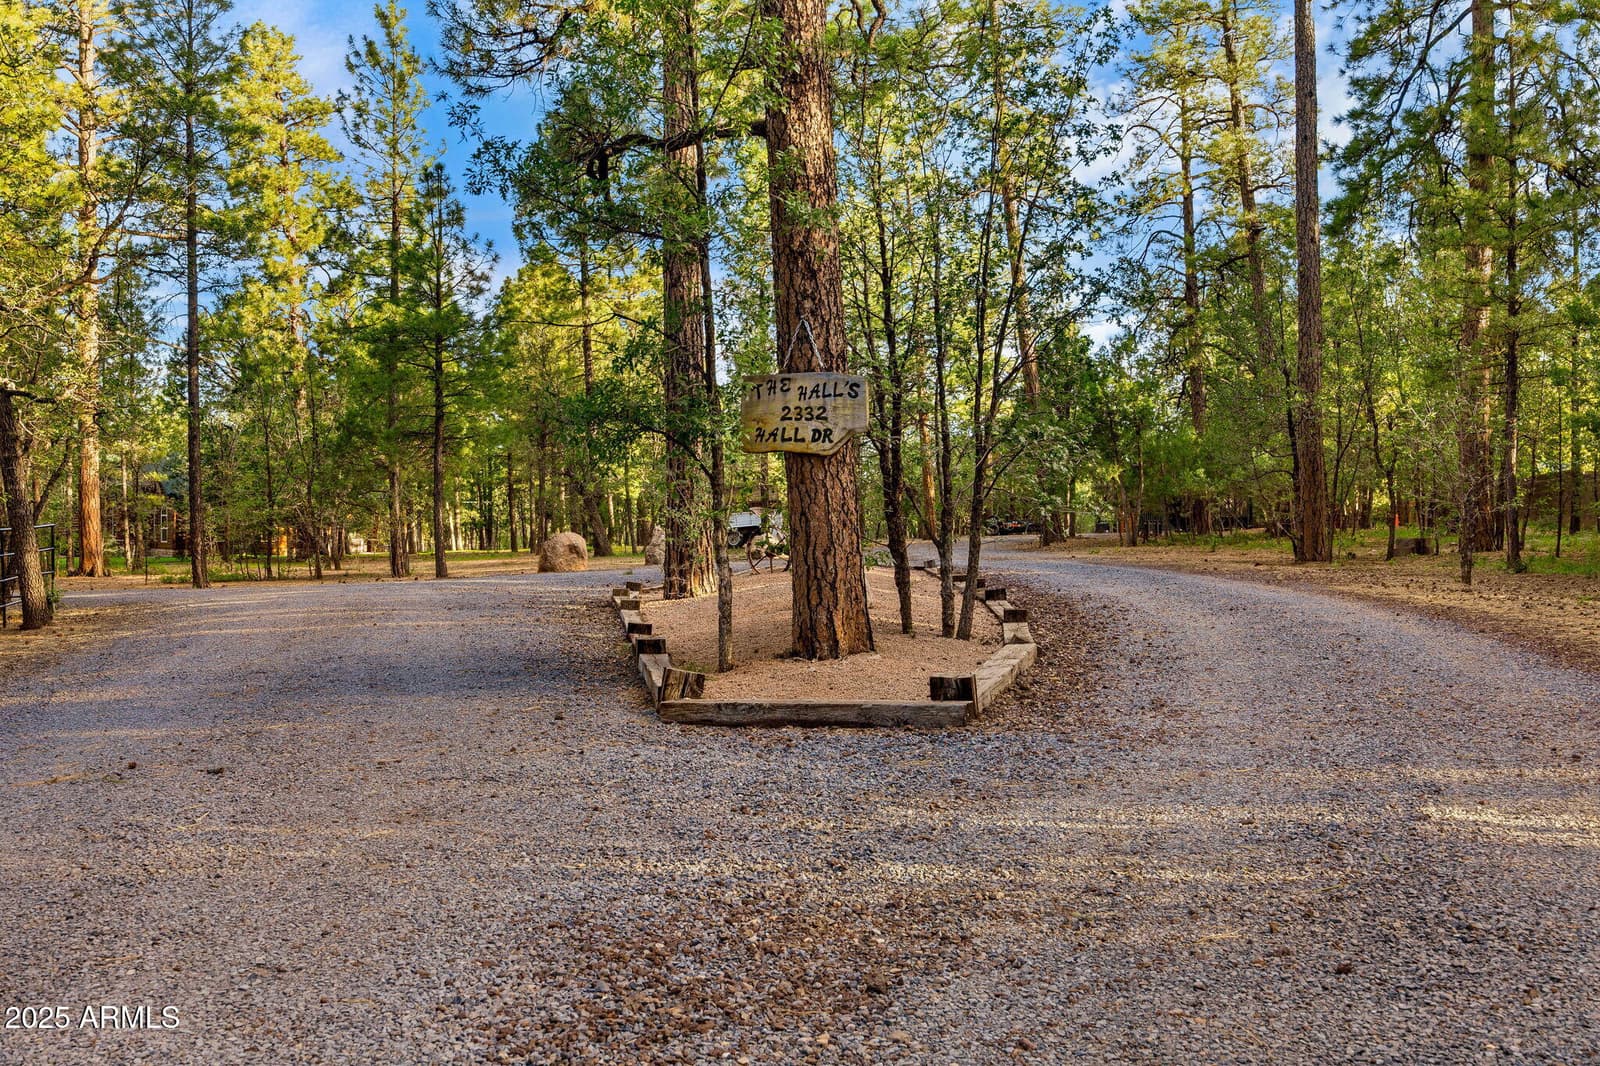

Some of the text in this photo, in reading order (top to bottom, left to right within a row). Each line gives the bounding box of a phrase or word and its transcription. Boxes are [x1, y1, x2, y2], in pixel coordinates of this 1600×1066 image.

[751, 378, 860, 401] THE HALL'S
[780, 405, 829, 422] 2332
[755, 427, 834, 443] HALL DR
